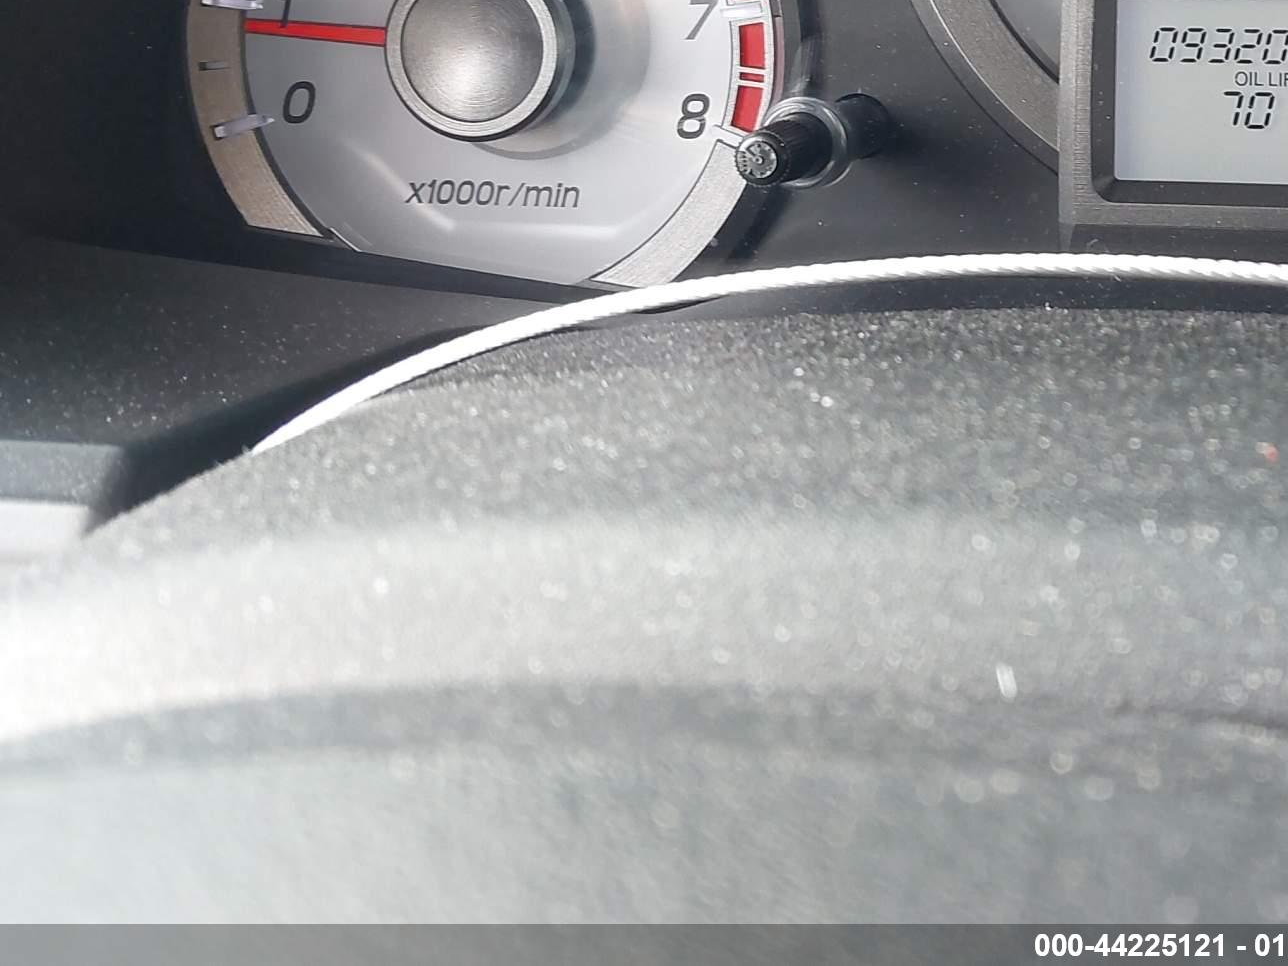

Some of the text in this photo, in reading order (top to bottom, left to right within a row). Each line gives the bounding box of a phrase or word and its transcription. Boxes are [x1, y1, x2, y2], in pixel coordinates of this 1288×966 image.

[1234, 71, 1265, 87] OIL
[282, 80, 317, 124] 0
[675, 93, 711, 139] 8
[1223, 90, 1276, 130] 70
[404, 181, 581, 209] x1000r/min
